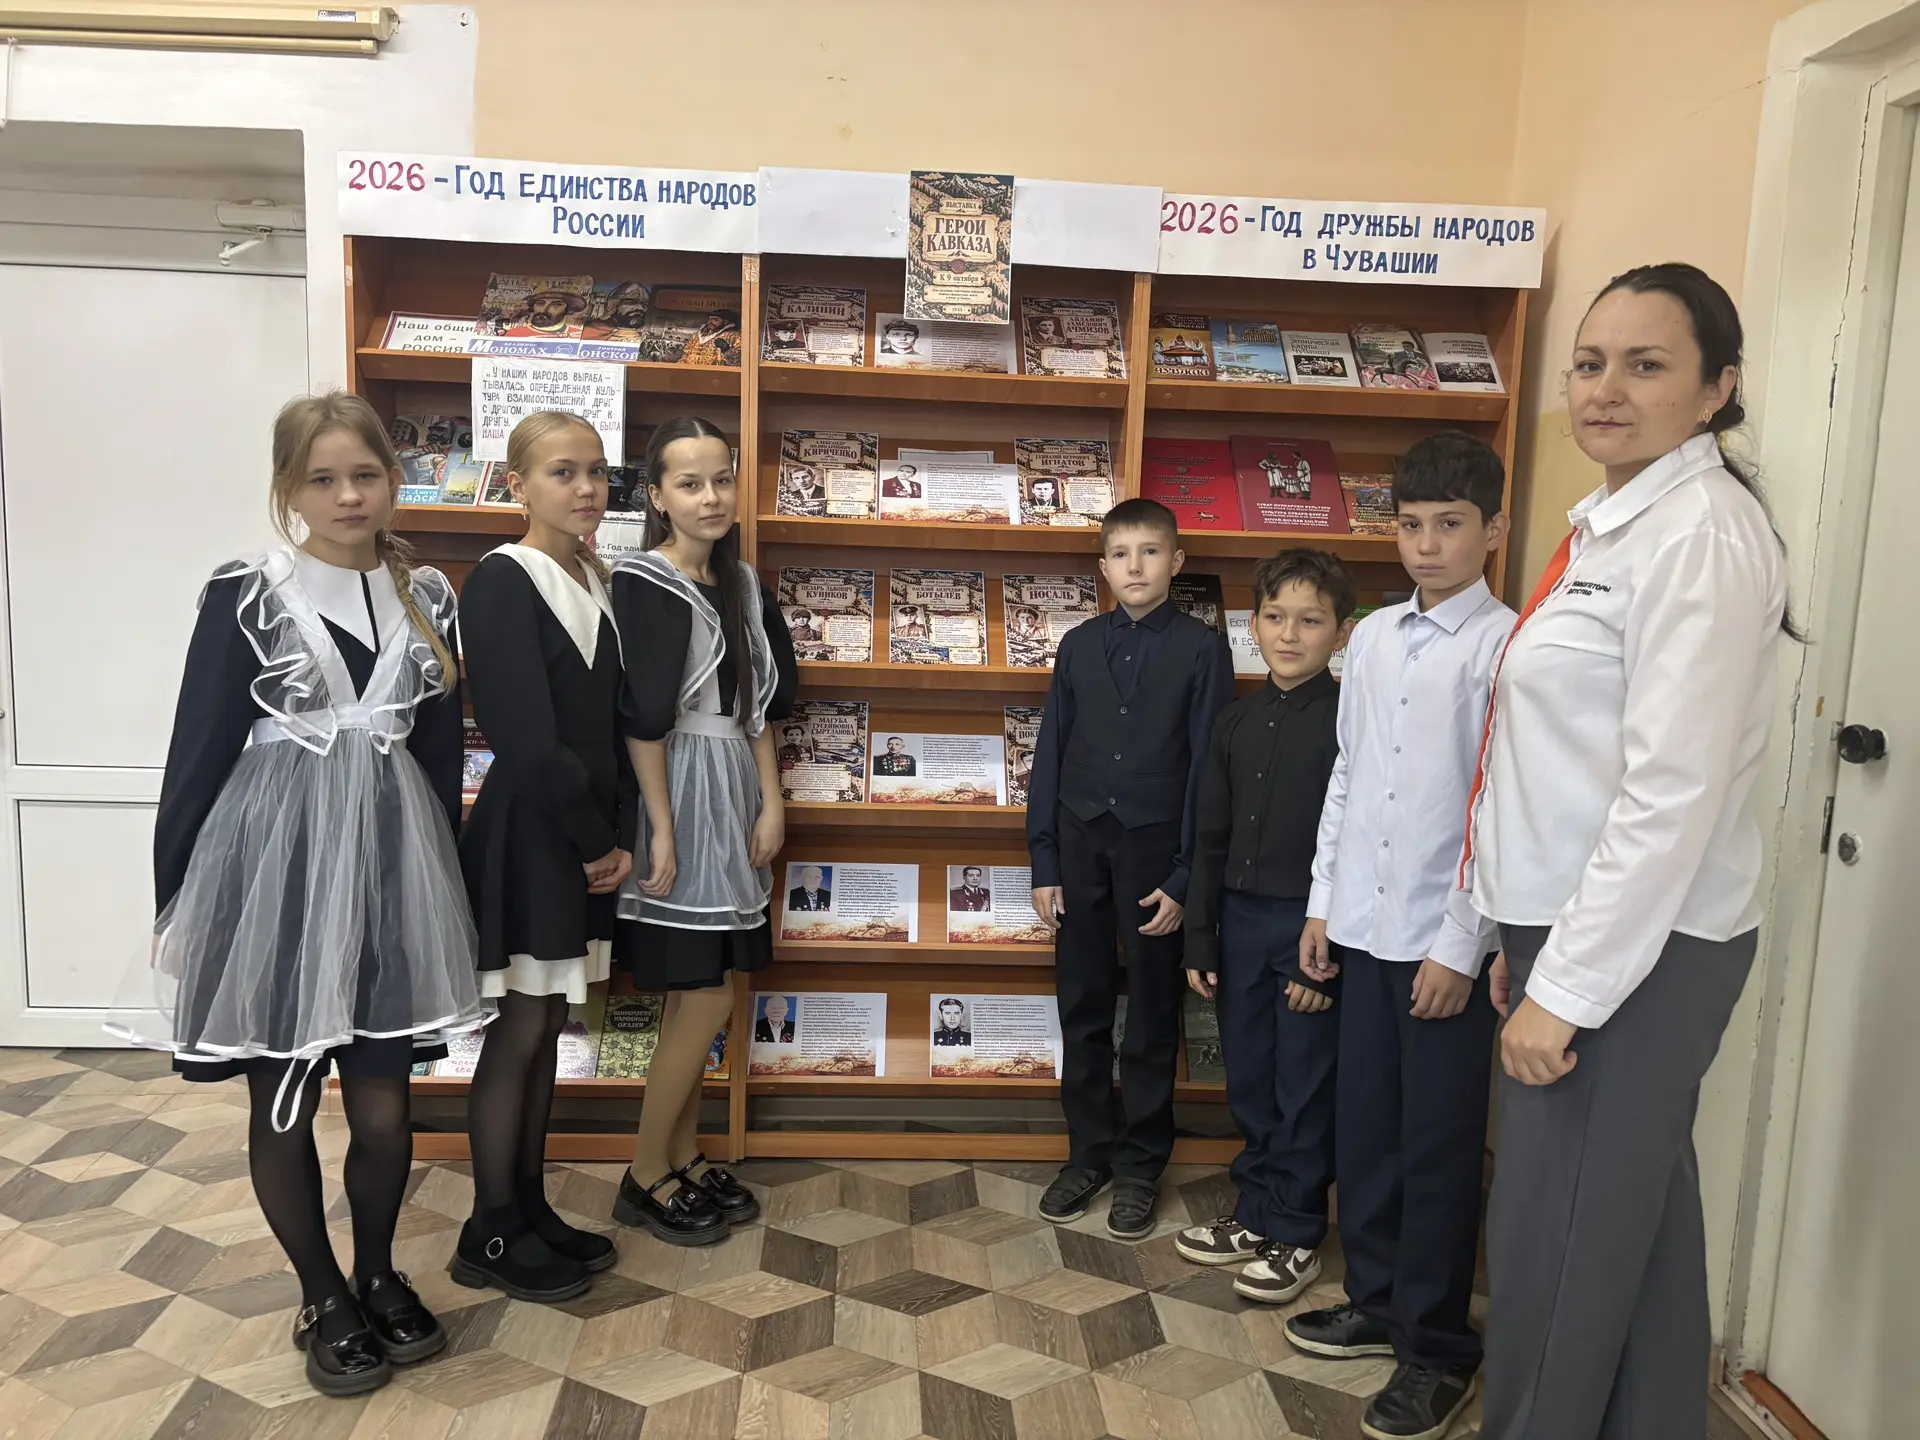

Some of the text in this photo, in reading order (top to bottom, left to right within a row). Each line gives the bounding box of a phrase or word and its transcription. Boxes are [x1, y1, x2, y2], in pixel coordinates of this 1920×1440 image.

[348, 159, 426, 191] 2026
[519, 173, 648, 203] ЕДИНСТВА
[658, 180, 757, 210] НАРОДОВ
[945, 201, 977, 210] ВЫСТАВКА
[935, 217, 987, 235] ГЕРОИ
[1160, 201, 1239, 234] 2026
[1433, 218, 1535, 246] НАРОДОВ
[926, 234, 993, 255] КАВКАЗА
[947, 273, 952, 281] 9
[953, 274, 979, 284] октября
[787, 304, 846, 316] КАЛИНИН
[396, 321, 475, 333] Наш общи
[1065, 326, 1109, 334] АЧМИЗОВ
[413, 334, 443, 342] дом
[402, 343, 464, 354] РОССИЯ
[579, 350, 639, 360] ОНСКОЙ
[501, 369, 528, 379] НАШИХ
[532, 370, 569, 382] НАРОДОВ
[482, 380, 525, 391] ТЫВАЛАСЬ
[482, 392, 500, 401] ТУРА
[591, 397, 614, 408] ДРУГ
[482, 404, 488, 413] С
[581, 409, 602, 418] ДРУГ
[607, 410, 613, 418] К
[599, 421, 622, 432] БЫЛА
[482, 428, 505, 439] НАША
[803, 448, 858, 460] КИРИЧЕНКО
[1041, 459, 1085, 467] ИГНАТОВ
[607, 543, 622, 551] Год
[806, 591, 848, 600] КУНИКОВ
[1029, 590, 1074, 600] НОСАЛЬ
[1231, 637, 1238, 646] И
